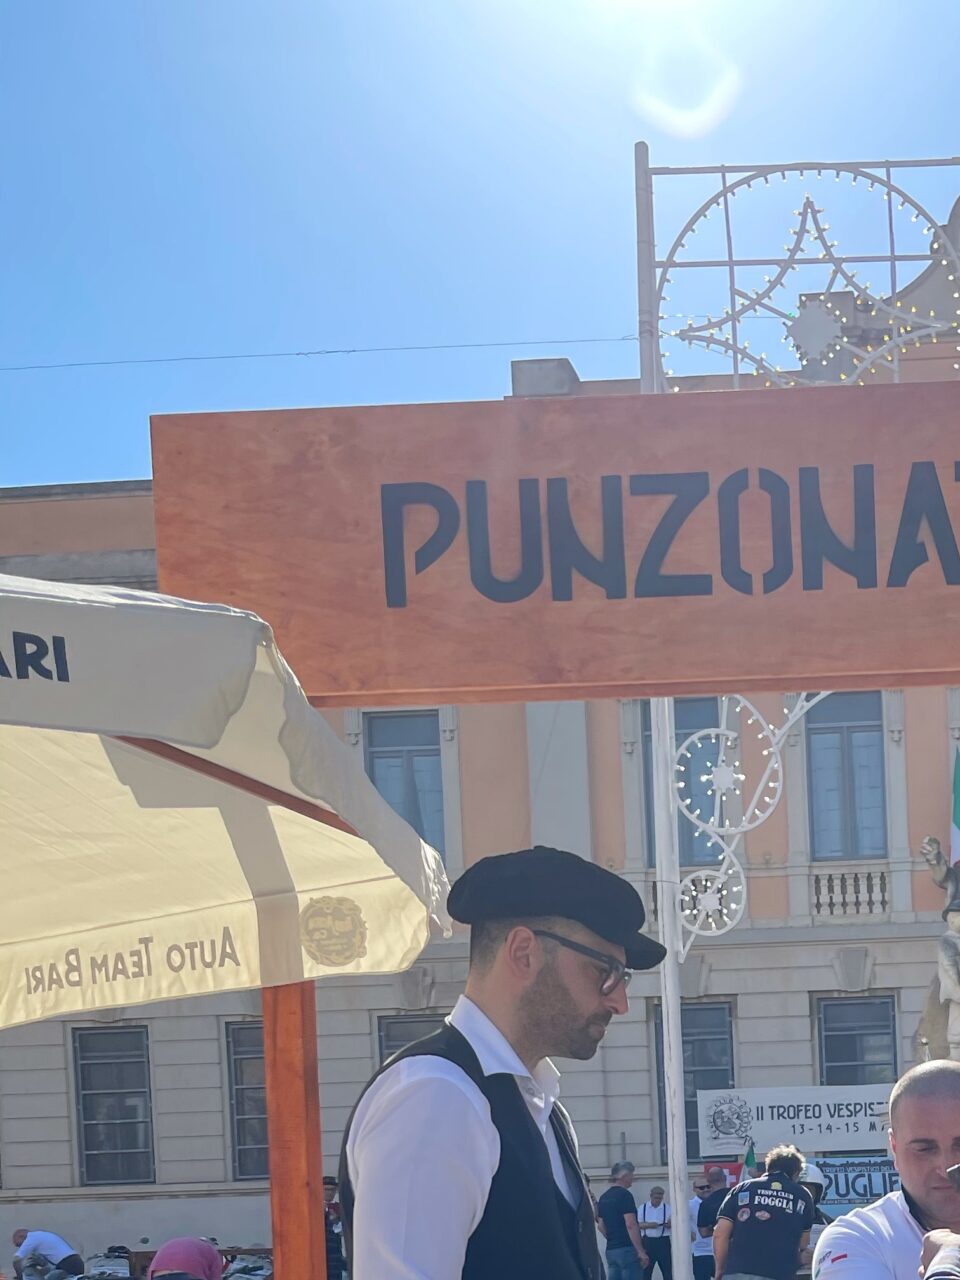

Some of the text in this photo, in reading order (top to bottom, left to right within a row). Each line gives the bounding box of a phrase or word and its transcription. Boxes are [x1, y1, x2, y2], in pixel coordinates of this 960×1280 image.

[0, 631, 70, 682] RI
[769, 1104, 822, 1120] TROFEO
[754, 1195, 793, 1211] FOGGIA
